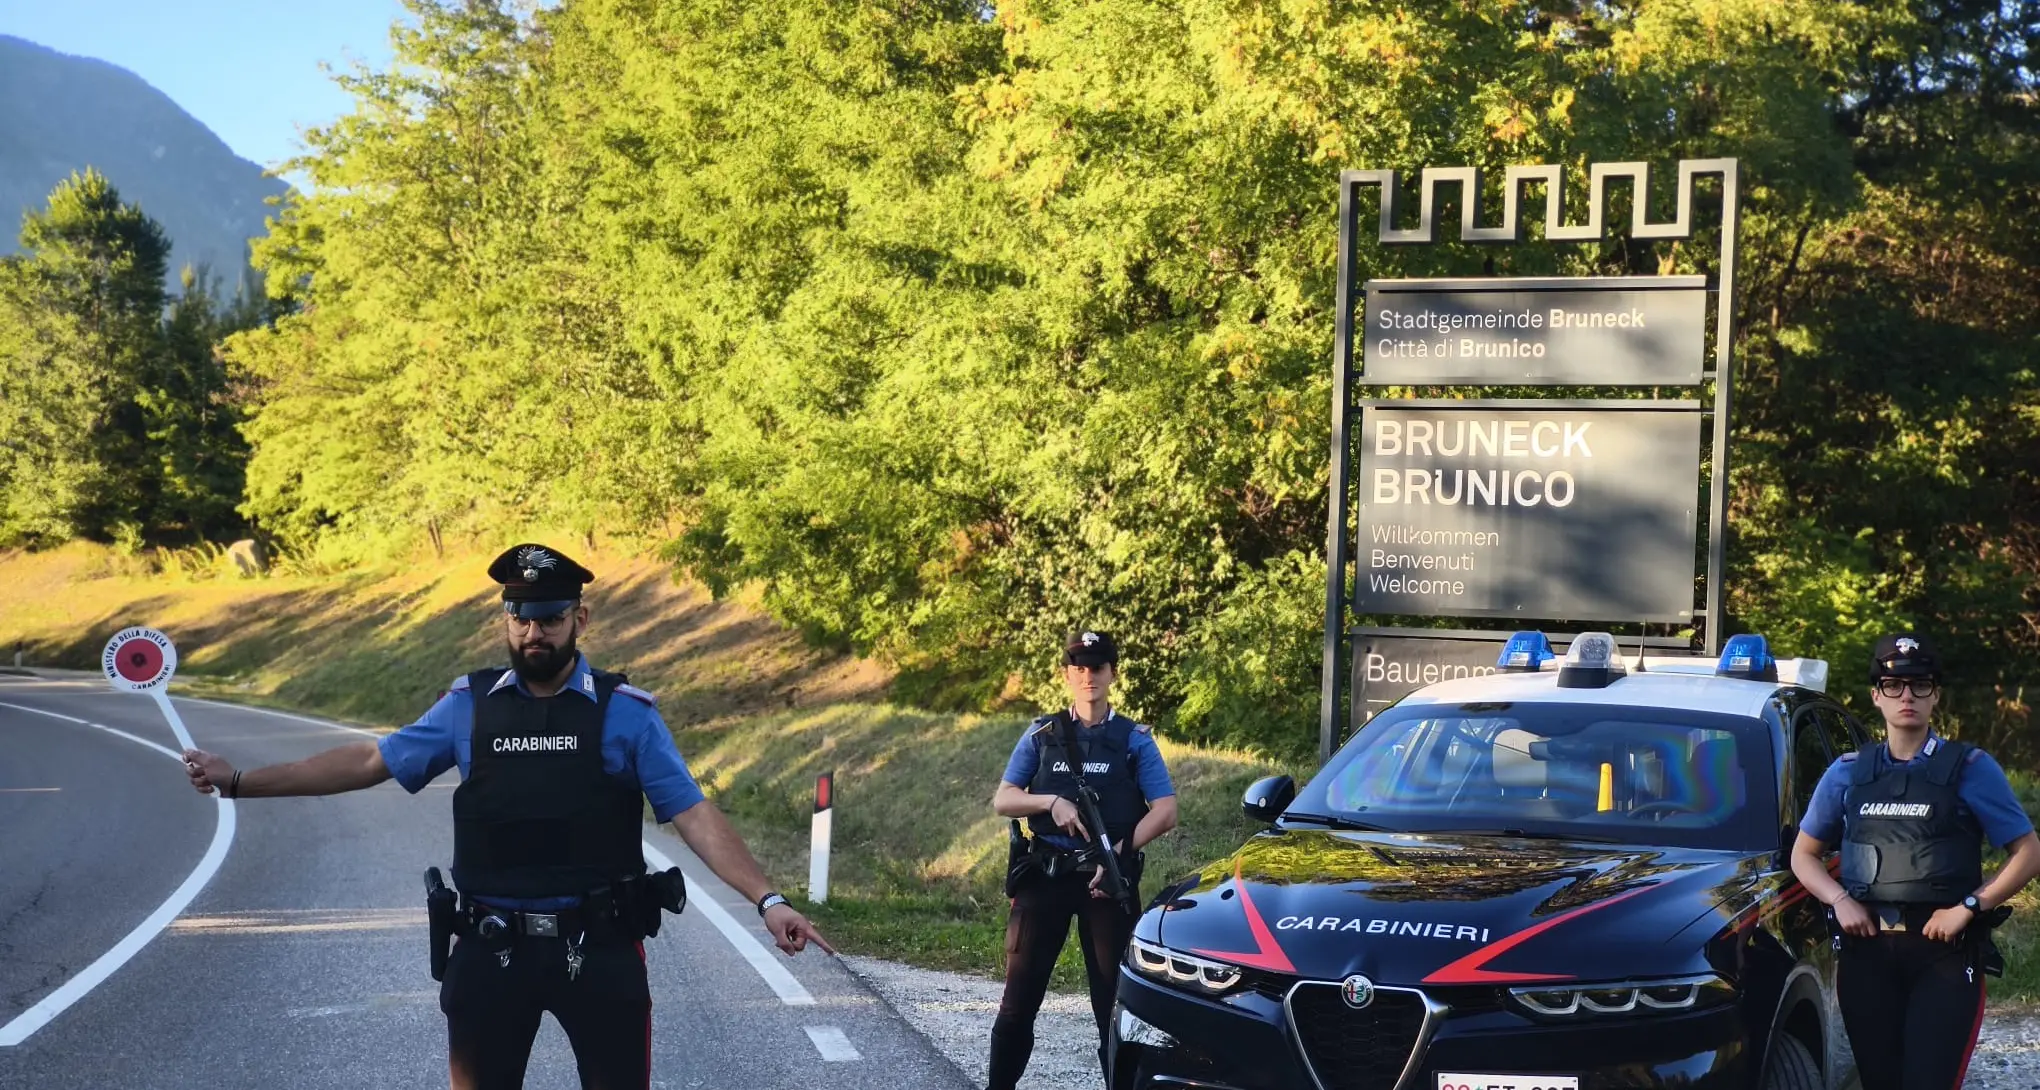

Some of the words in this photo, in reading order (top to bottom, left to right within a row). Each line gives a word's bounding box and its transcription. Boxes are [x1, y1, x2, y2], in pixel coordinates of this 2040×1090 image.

[1379, 309, 1543, 333] Stadtgemeinde
[1549, 308, 1645, 328] Bruneck
[1378, 338, 1428, 358] Città
[1434, 338, 1454, 358] di
[1460, 338, 1546, 358] Brunico
[1375, 419, 1593, 457] BRUNECK
[1373, 468, 1575, 507] BRUNICO
[1371, 524, 1499, 547] Willkommen
[1371, 549, 1475, 571] Benvenuti
[1370, 573, 1464, 595] Welcome
[105, 641, 119, 678] MINISTERO
[118, 629, 140, 642] DELLA
[144, 630, 168, 648] DIFESA
[131, 664, 172, 690] CARABINIERI
[493, 735, 577, 752] CARABINIERI
[1859, 803, 1931, 817] CARABINIERI
[1275, 915, 1490, 943] CARABINIERI
